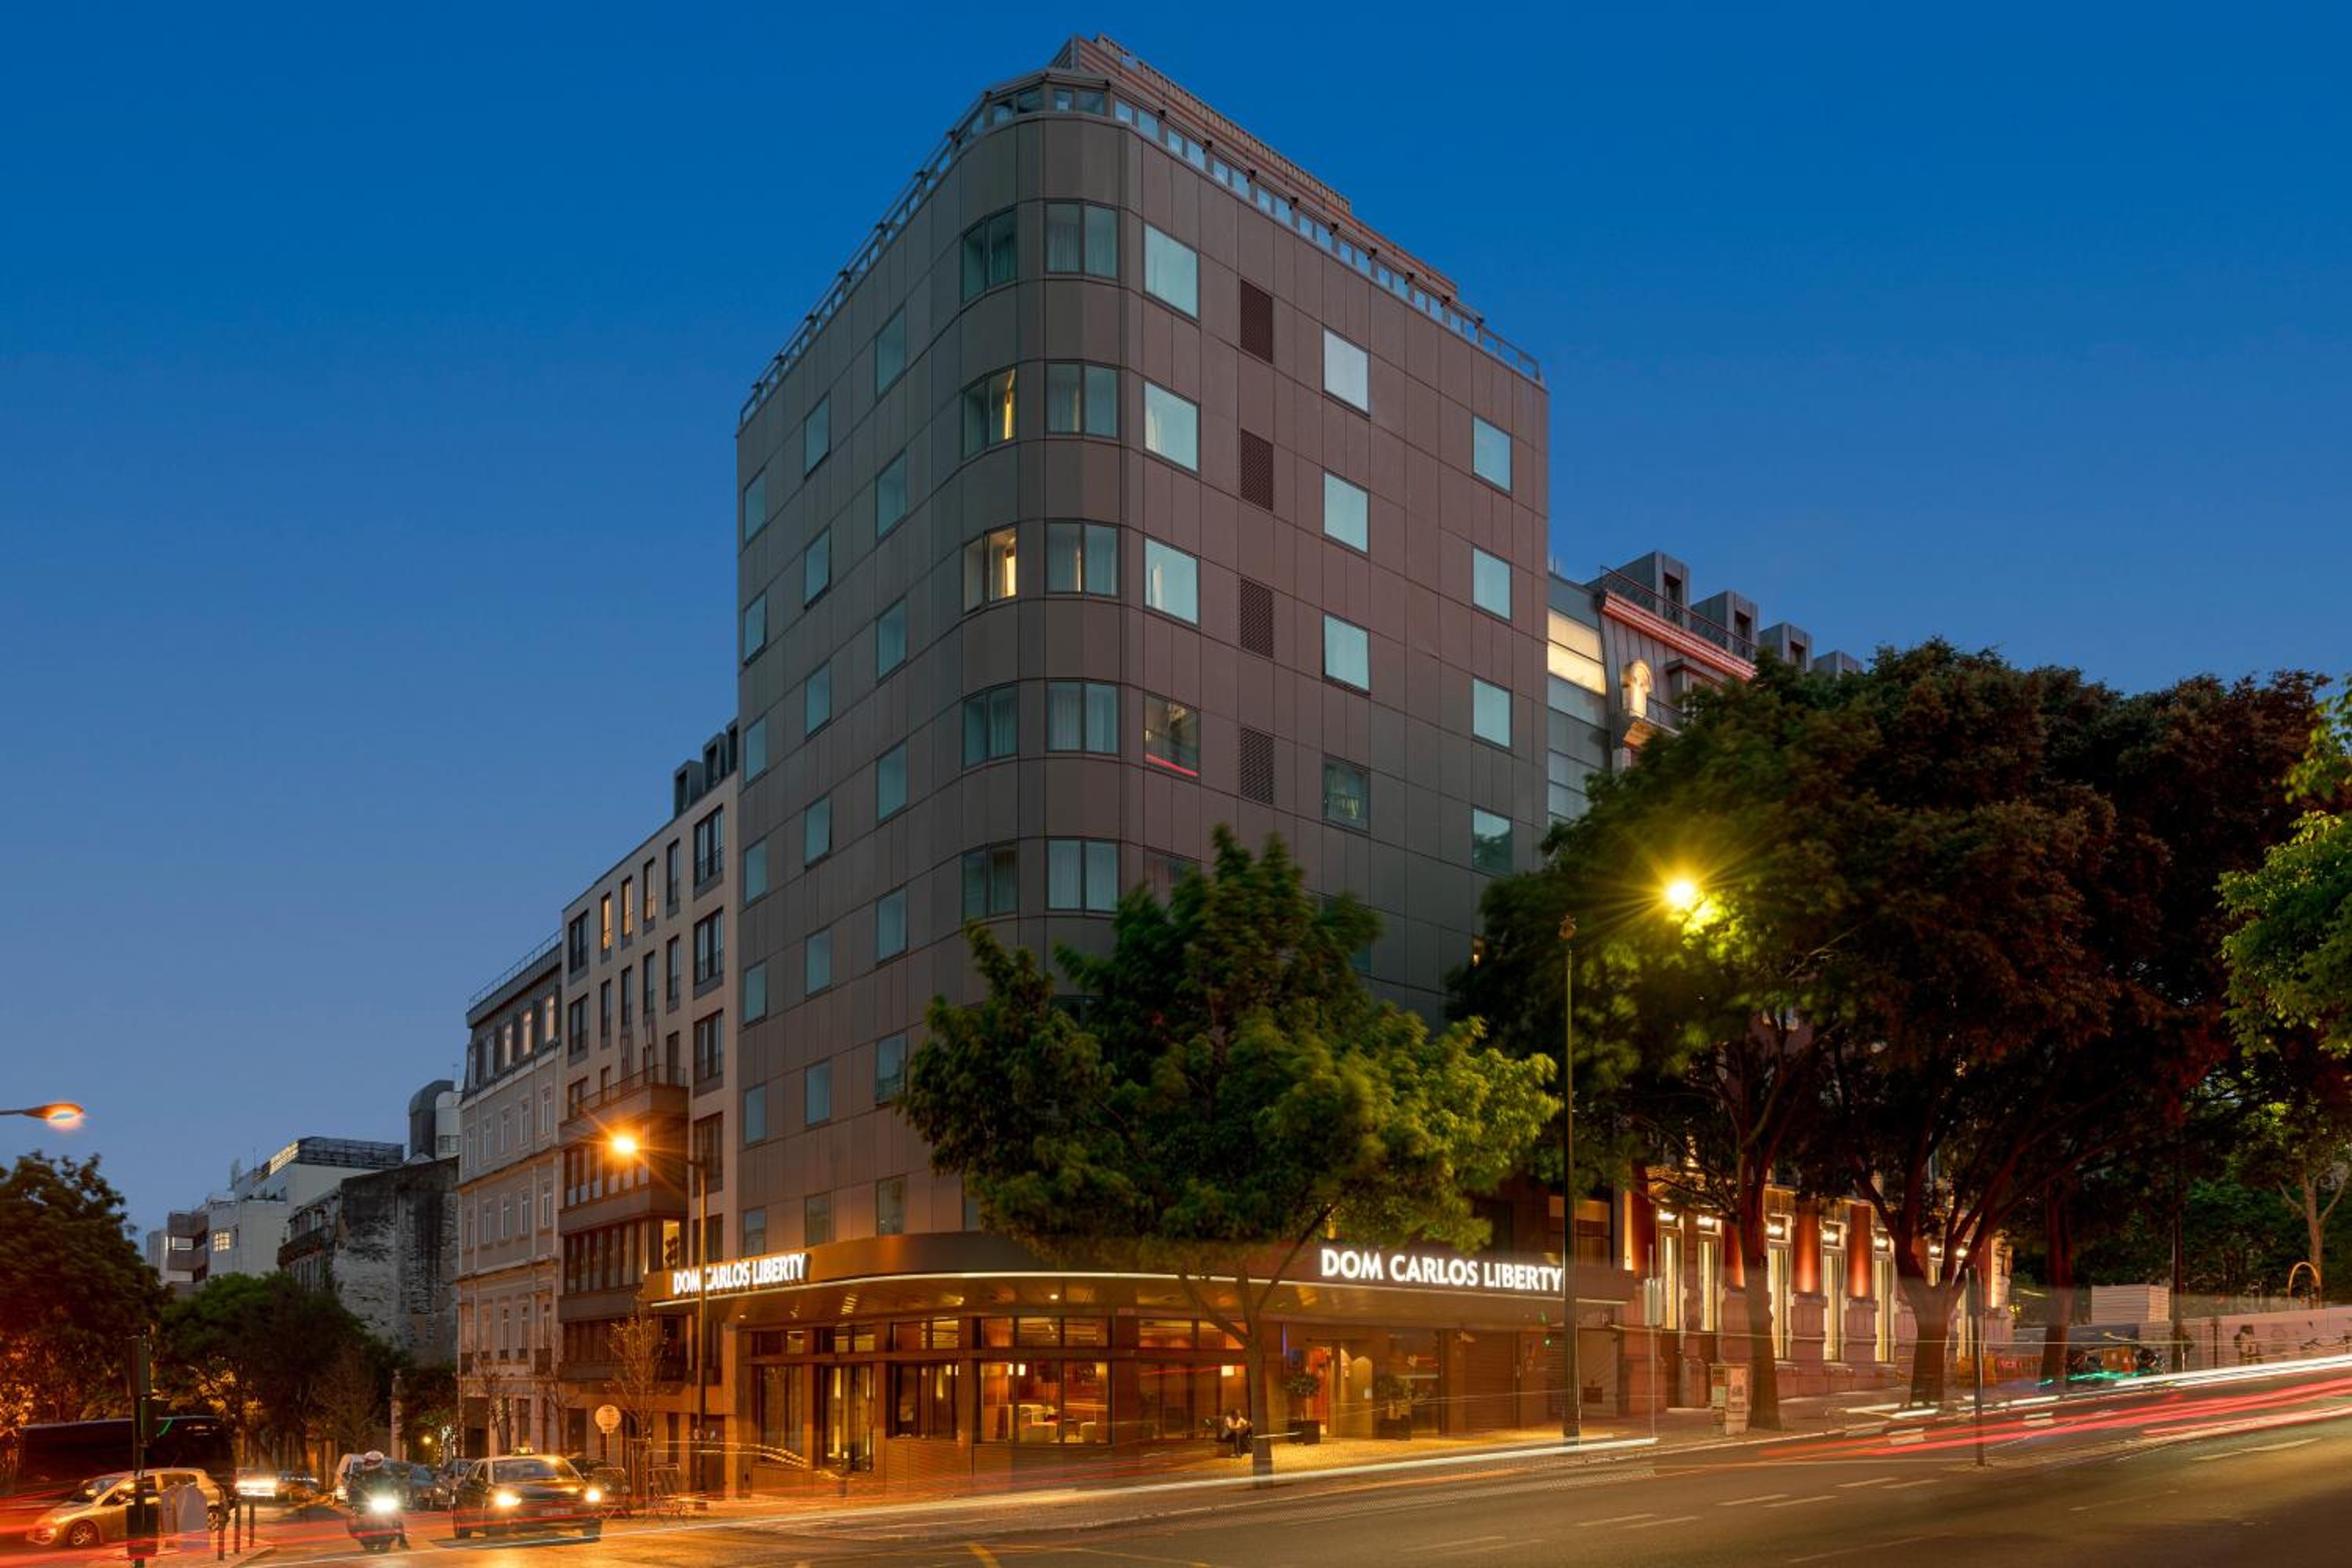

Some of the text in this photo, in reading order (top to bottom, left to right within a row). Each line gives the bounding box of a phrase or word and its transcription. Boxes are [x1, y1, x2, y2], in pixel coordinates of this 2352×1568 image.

[673, 1268, 701, 1294] DOM
[752, 1253, 807, 1284] LIBERTY
[1321, 1249, 1564, 1291] DOM CARLOS LIBERTY
